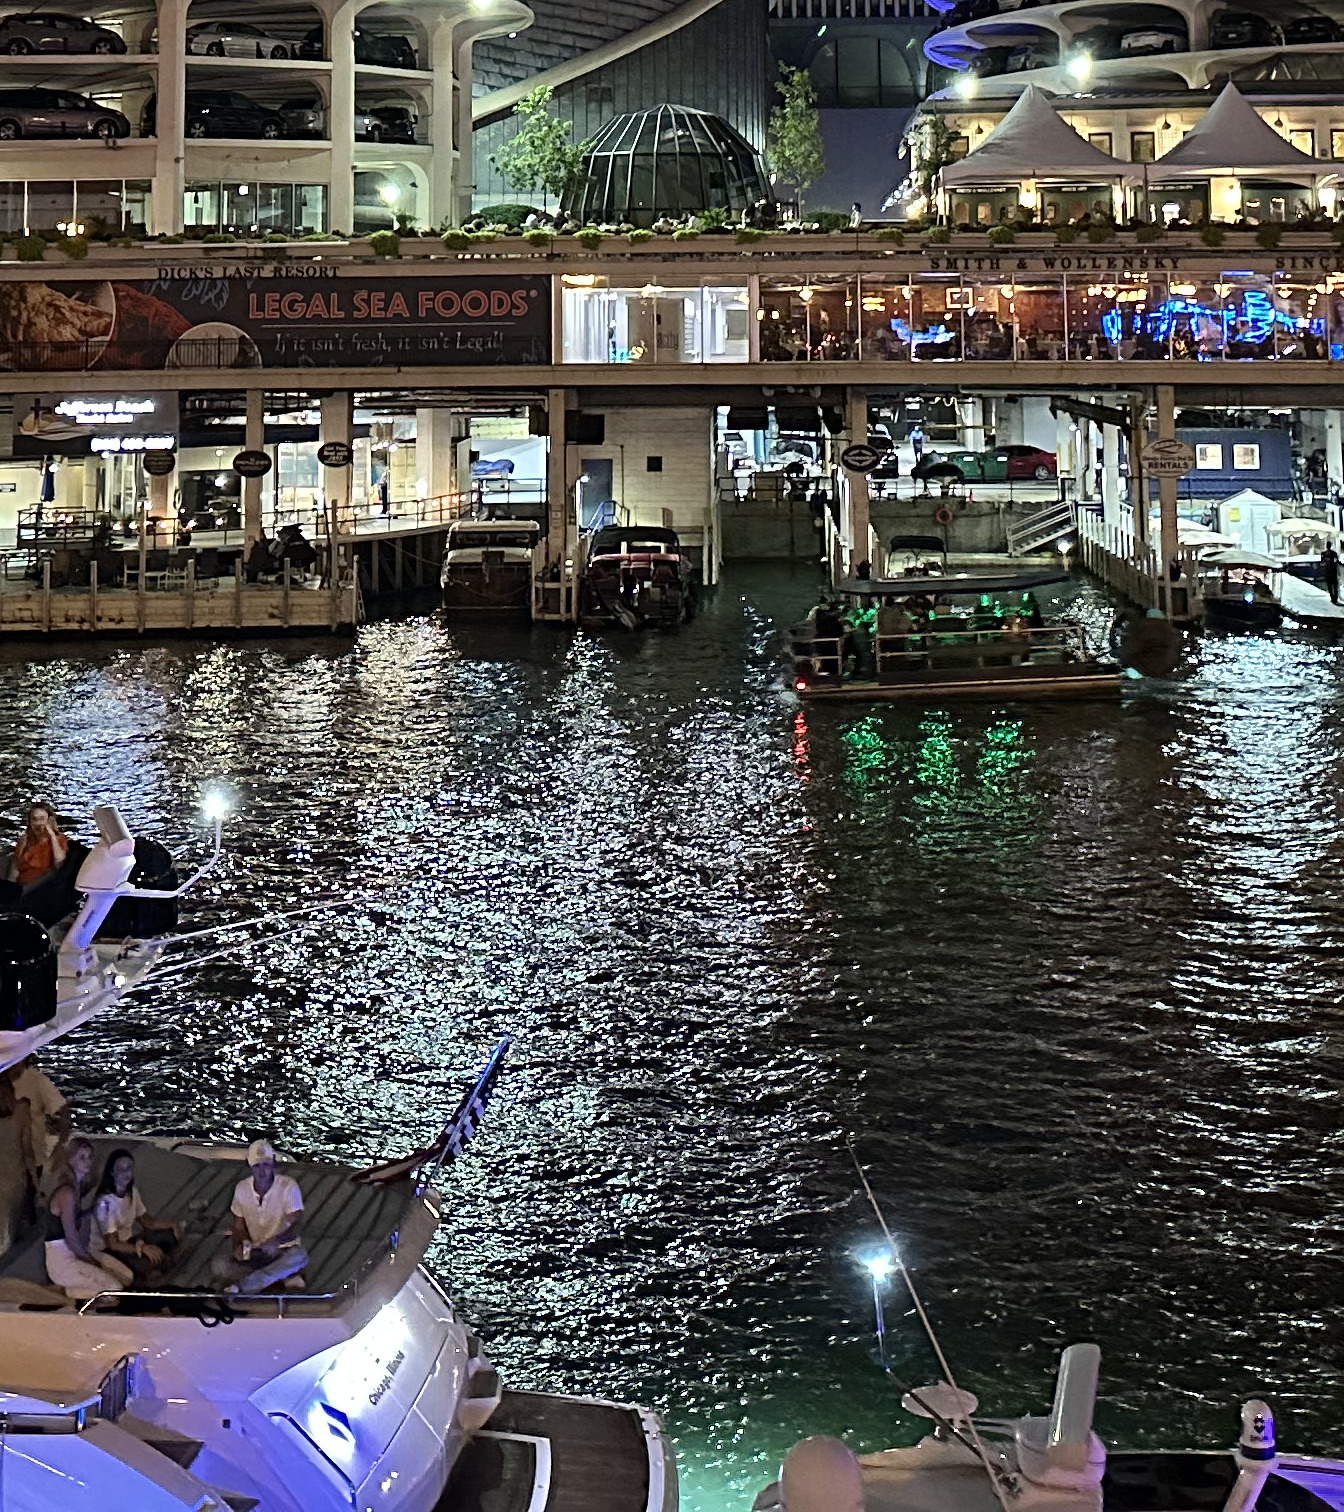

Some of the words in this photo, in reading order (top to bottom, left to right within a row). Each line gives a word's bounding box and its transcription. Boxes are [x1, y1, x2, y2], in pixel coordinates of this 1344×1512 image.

[930, 256, 1001, 270] SMITH
[1016, 257, 1029, 270] &
[1042, 256, 1182, 270] WOLLENSKY
[157, 266, 214, 279] DICK'S
[222, 266, 265, 279] LAST
[272, 265, 341, 278] RESORT
[248, 292, 345, 319] LEGAL
[353, 290, 410, 318] SEA
[311, 332, 344, 351] isn't
[1147, 461, 1189, 469] RENTALS
